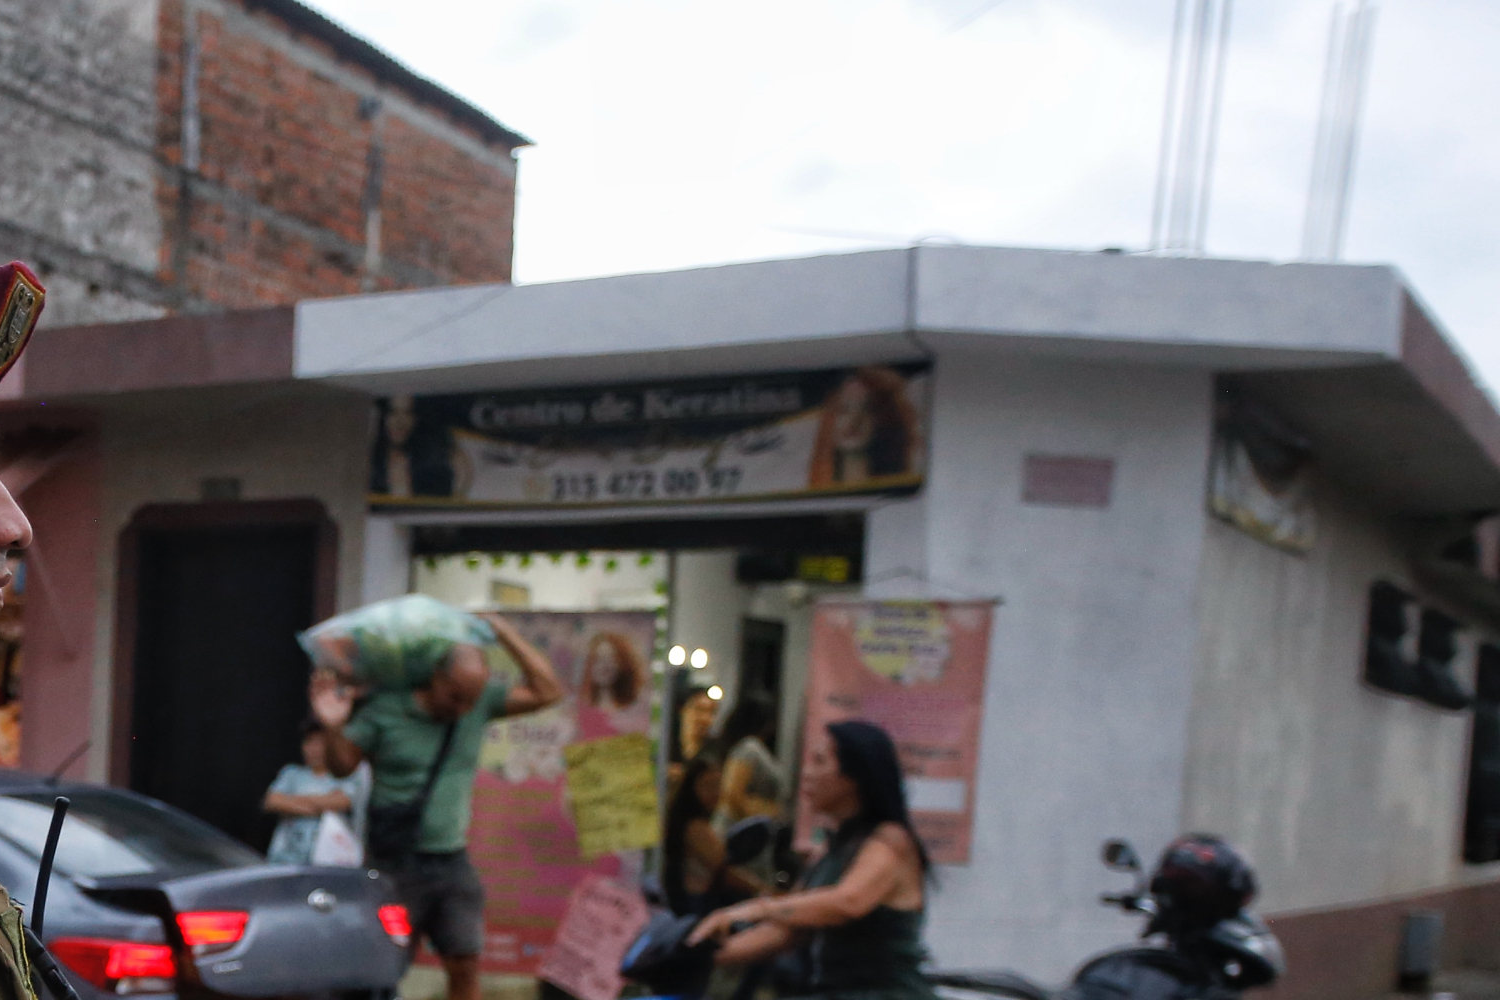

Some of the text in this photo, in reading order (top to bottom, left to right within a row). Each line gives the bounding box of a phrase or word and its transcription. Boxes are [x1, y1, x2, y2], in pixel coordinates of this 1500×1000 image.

[469, 383, 801, 428] Centro de Keratina
